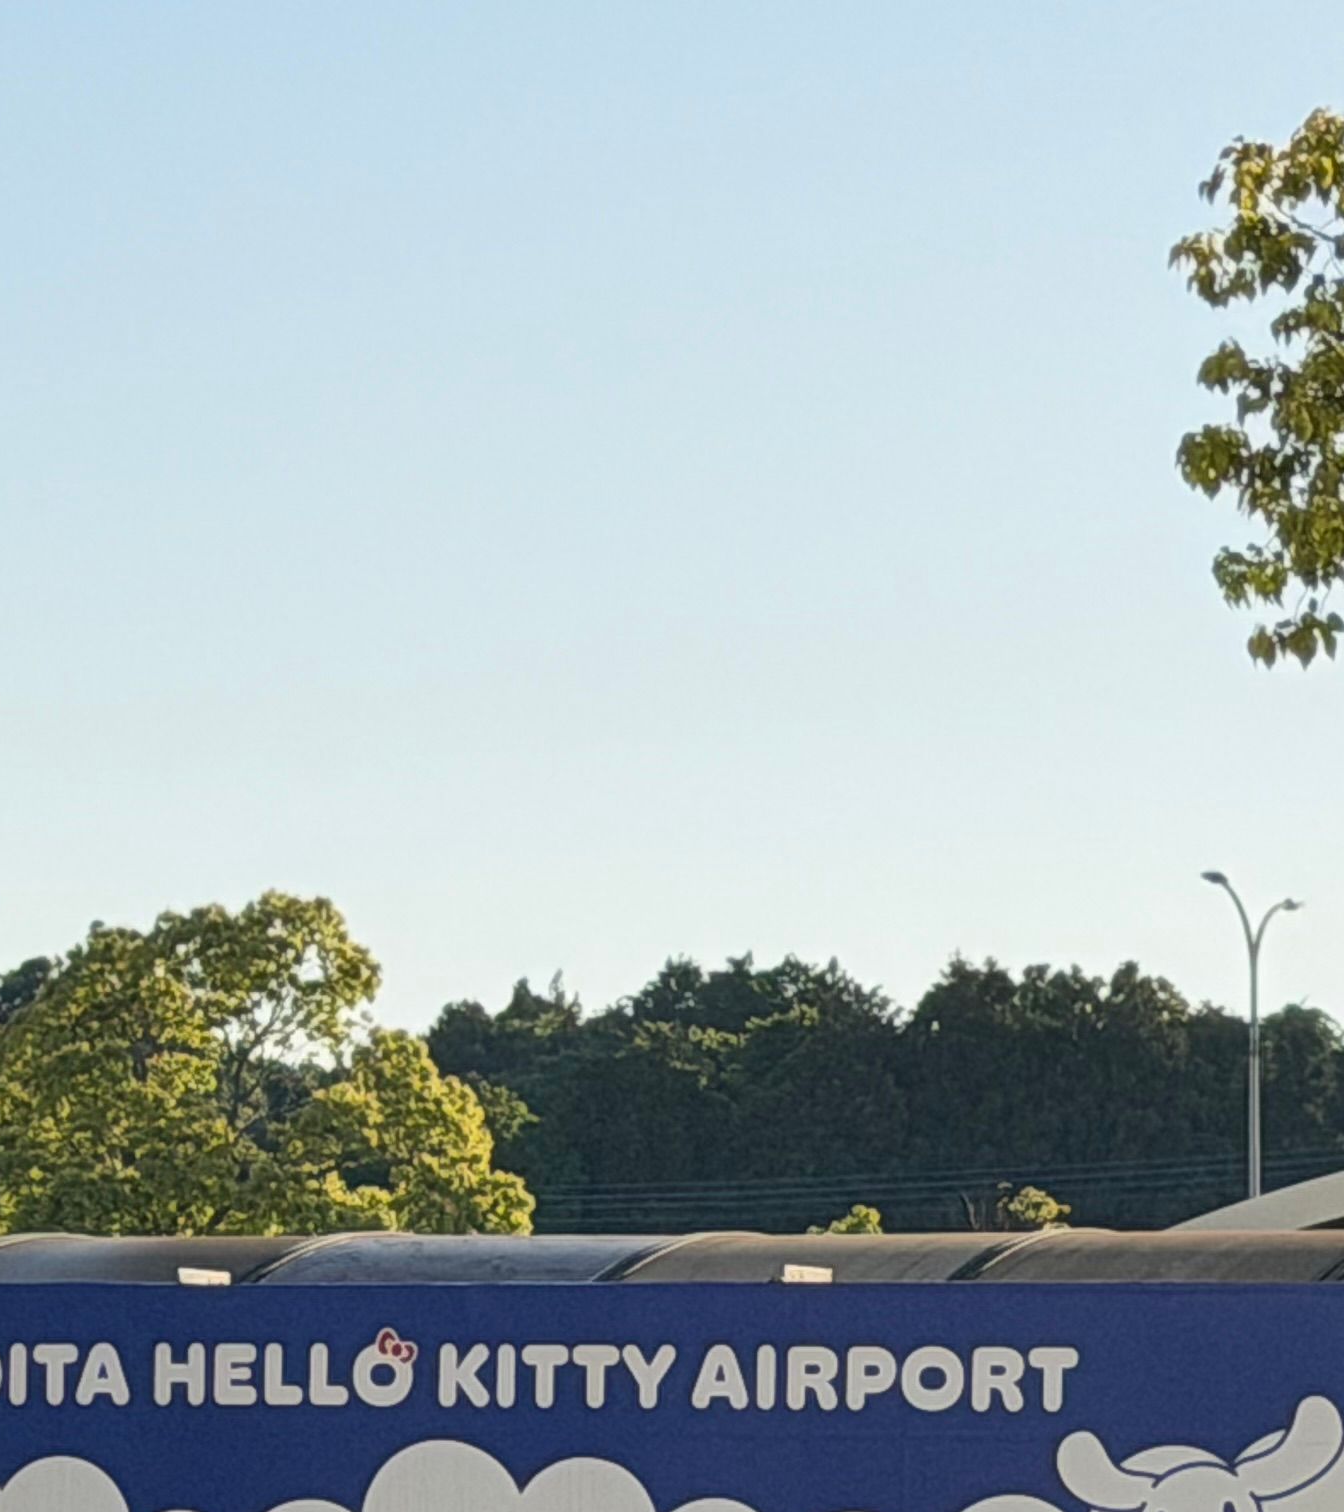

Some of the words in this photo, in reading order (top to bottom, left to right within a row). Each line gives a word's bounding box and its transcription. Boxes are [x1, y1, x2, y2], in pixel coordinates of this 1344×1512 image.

[153, 1342, 413, 1407] HELLO
[437, 1343, 677, 1408] KITTY
[690, 1344, 1080, 1412] AIRPORT
